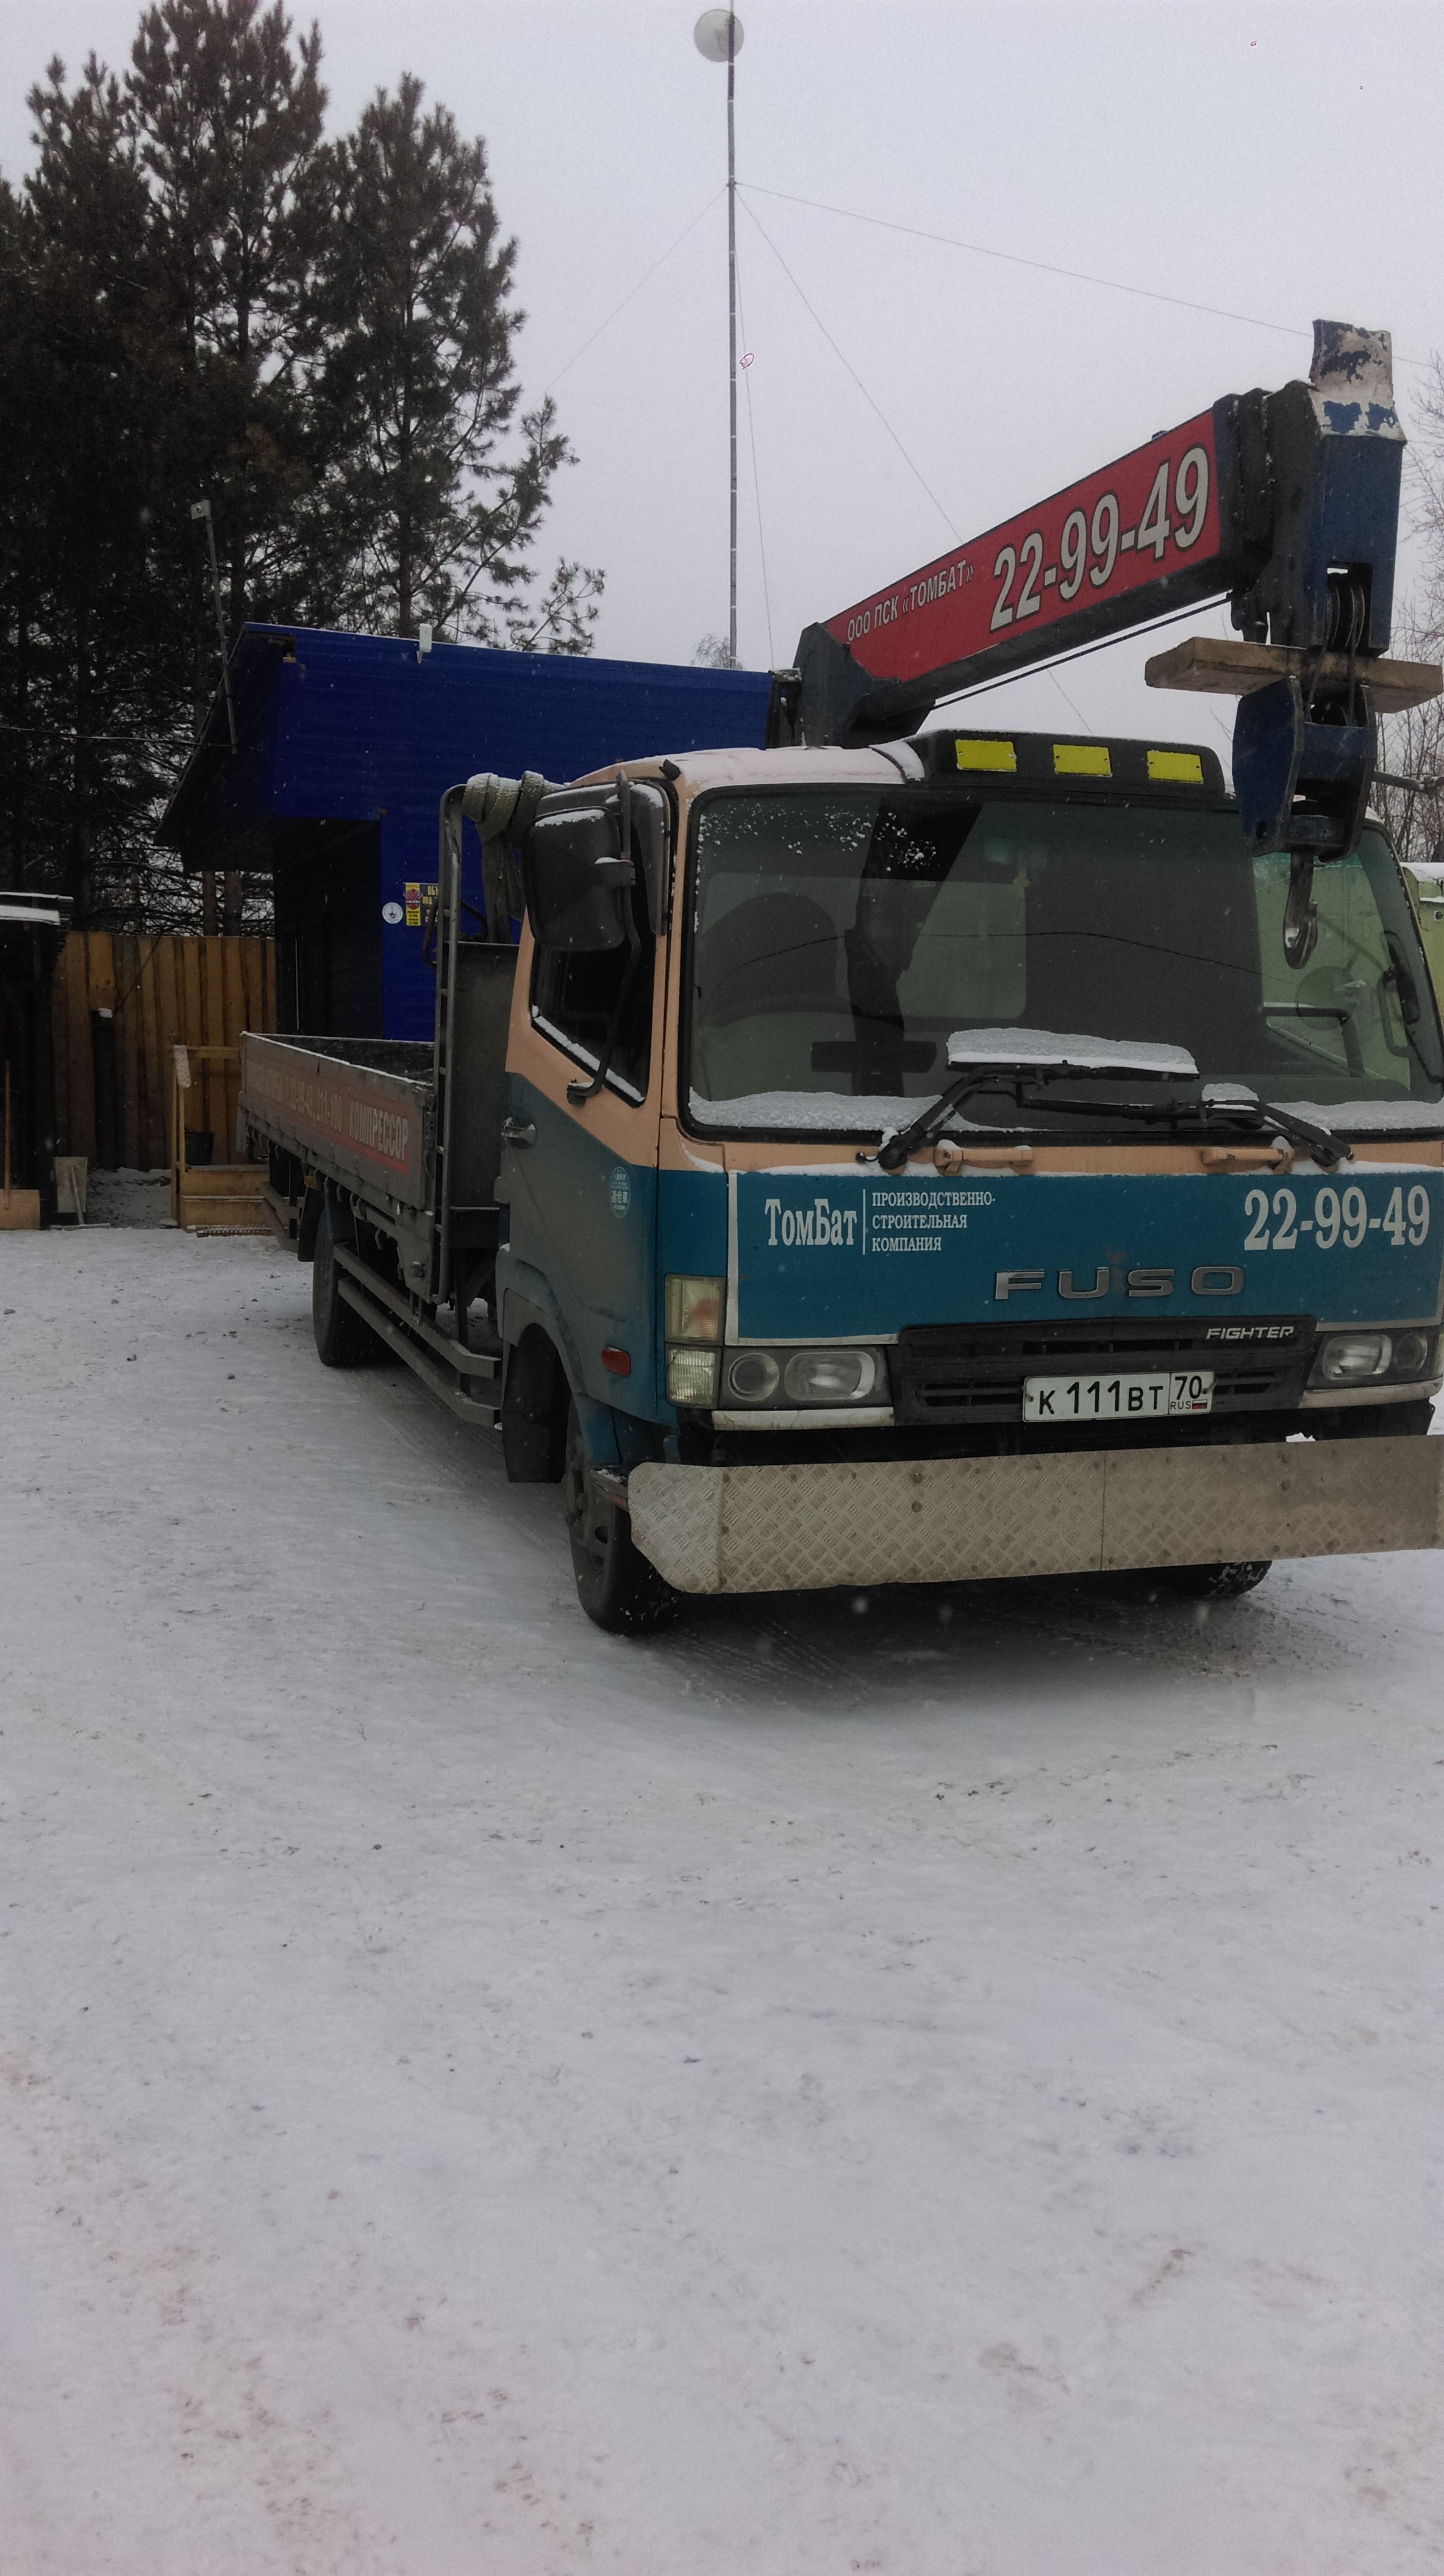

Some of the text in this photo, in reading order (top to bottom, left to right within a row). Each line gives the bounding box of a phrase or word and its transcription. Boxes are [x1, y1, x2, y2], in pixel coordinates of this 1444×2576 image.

[989, 446, 1210, 631] 22-99-49
[847, 610, 871, 642] ООО
[874, 594, 899, 630] ПСК
[348, 1098, 409, 1161] КОМПРЕССОР
[871, 1191, 996, 1209] ПРОИЗВОДСТВЕННО-
[764, 1198, 857, 1246] ТомБат
[871, 1214, 968, 1229] СТРОИТЕЛЬНАЯ
[1243, 1185, 1430, 1251] 22-99-49
[871, 1236, 942, 1252] КОМПАНИЯ
[994, 1265, 1245, 1300] FUSO
[1206, 1325, 1295, 1340] FIGHTER
[1174, 1375, 1203, 1401] 70
[1170, 1401, 1192, 1411] RUS
